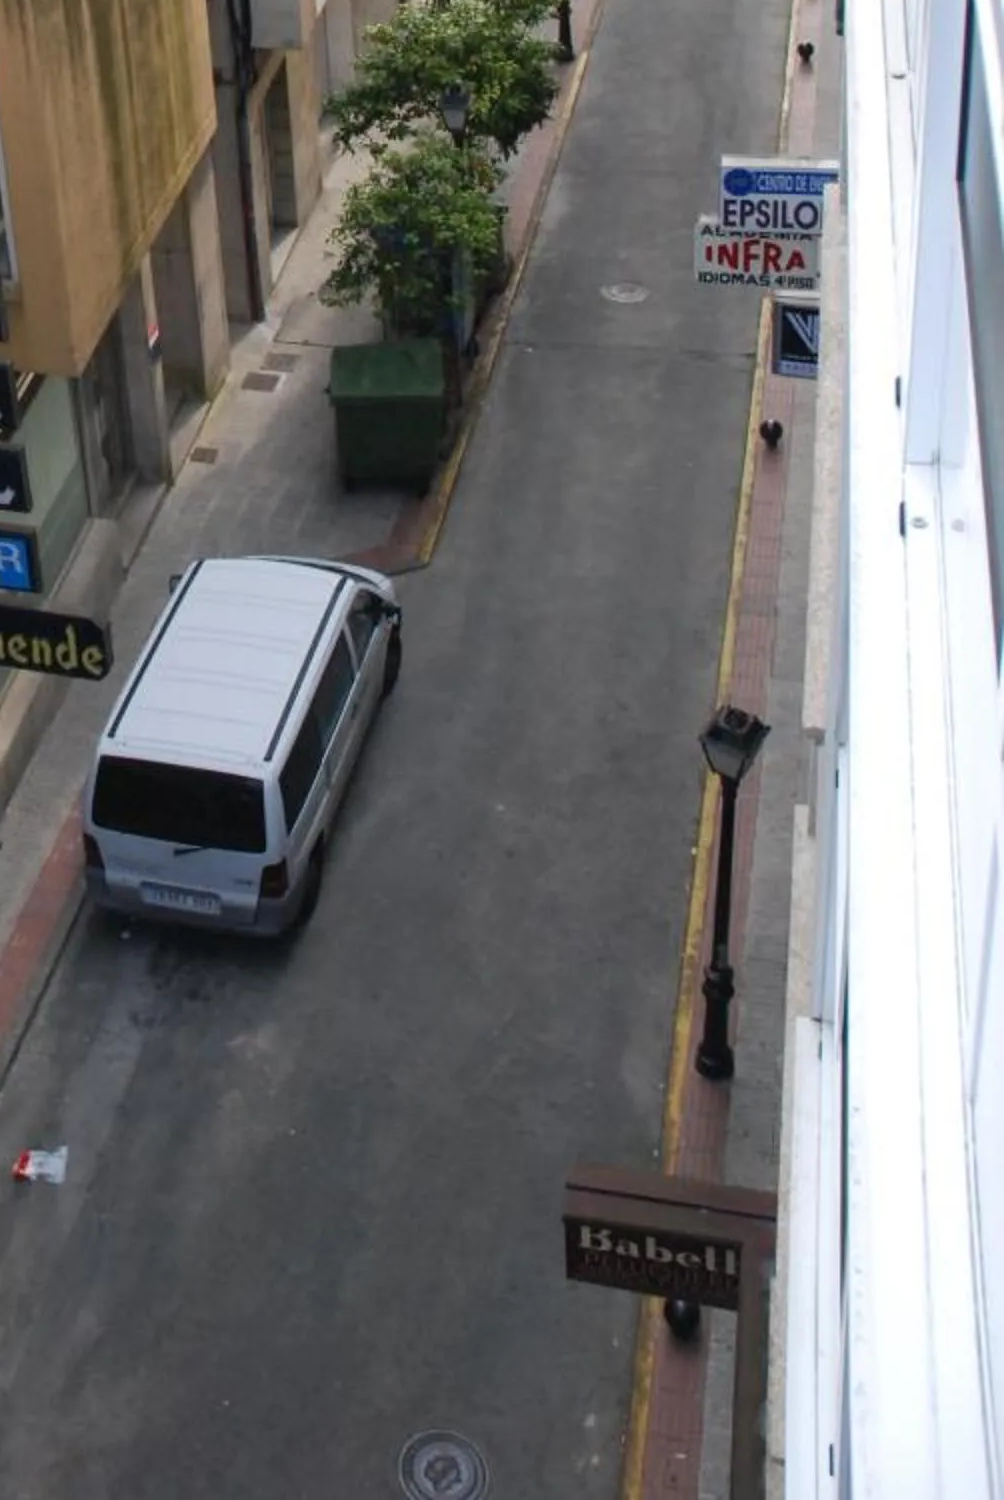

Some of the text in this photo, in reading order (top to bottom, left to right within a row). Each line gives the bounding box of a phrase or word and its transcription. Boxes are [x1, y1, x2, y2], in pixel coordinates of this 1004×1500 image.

[723, 198, 823, 230] EPSILO
[705, 240, 805, 274] INFRA
[698, 271, 770, 287] IDIOMAS
[579, 1224, 736, 1276] Babell
